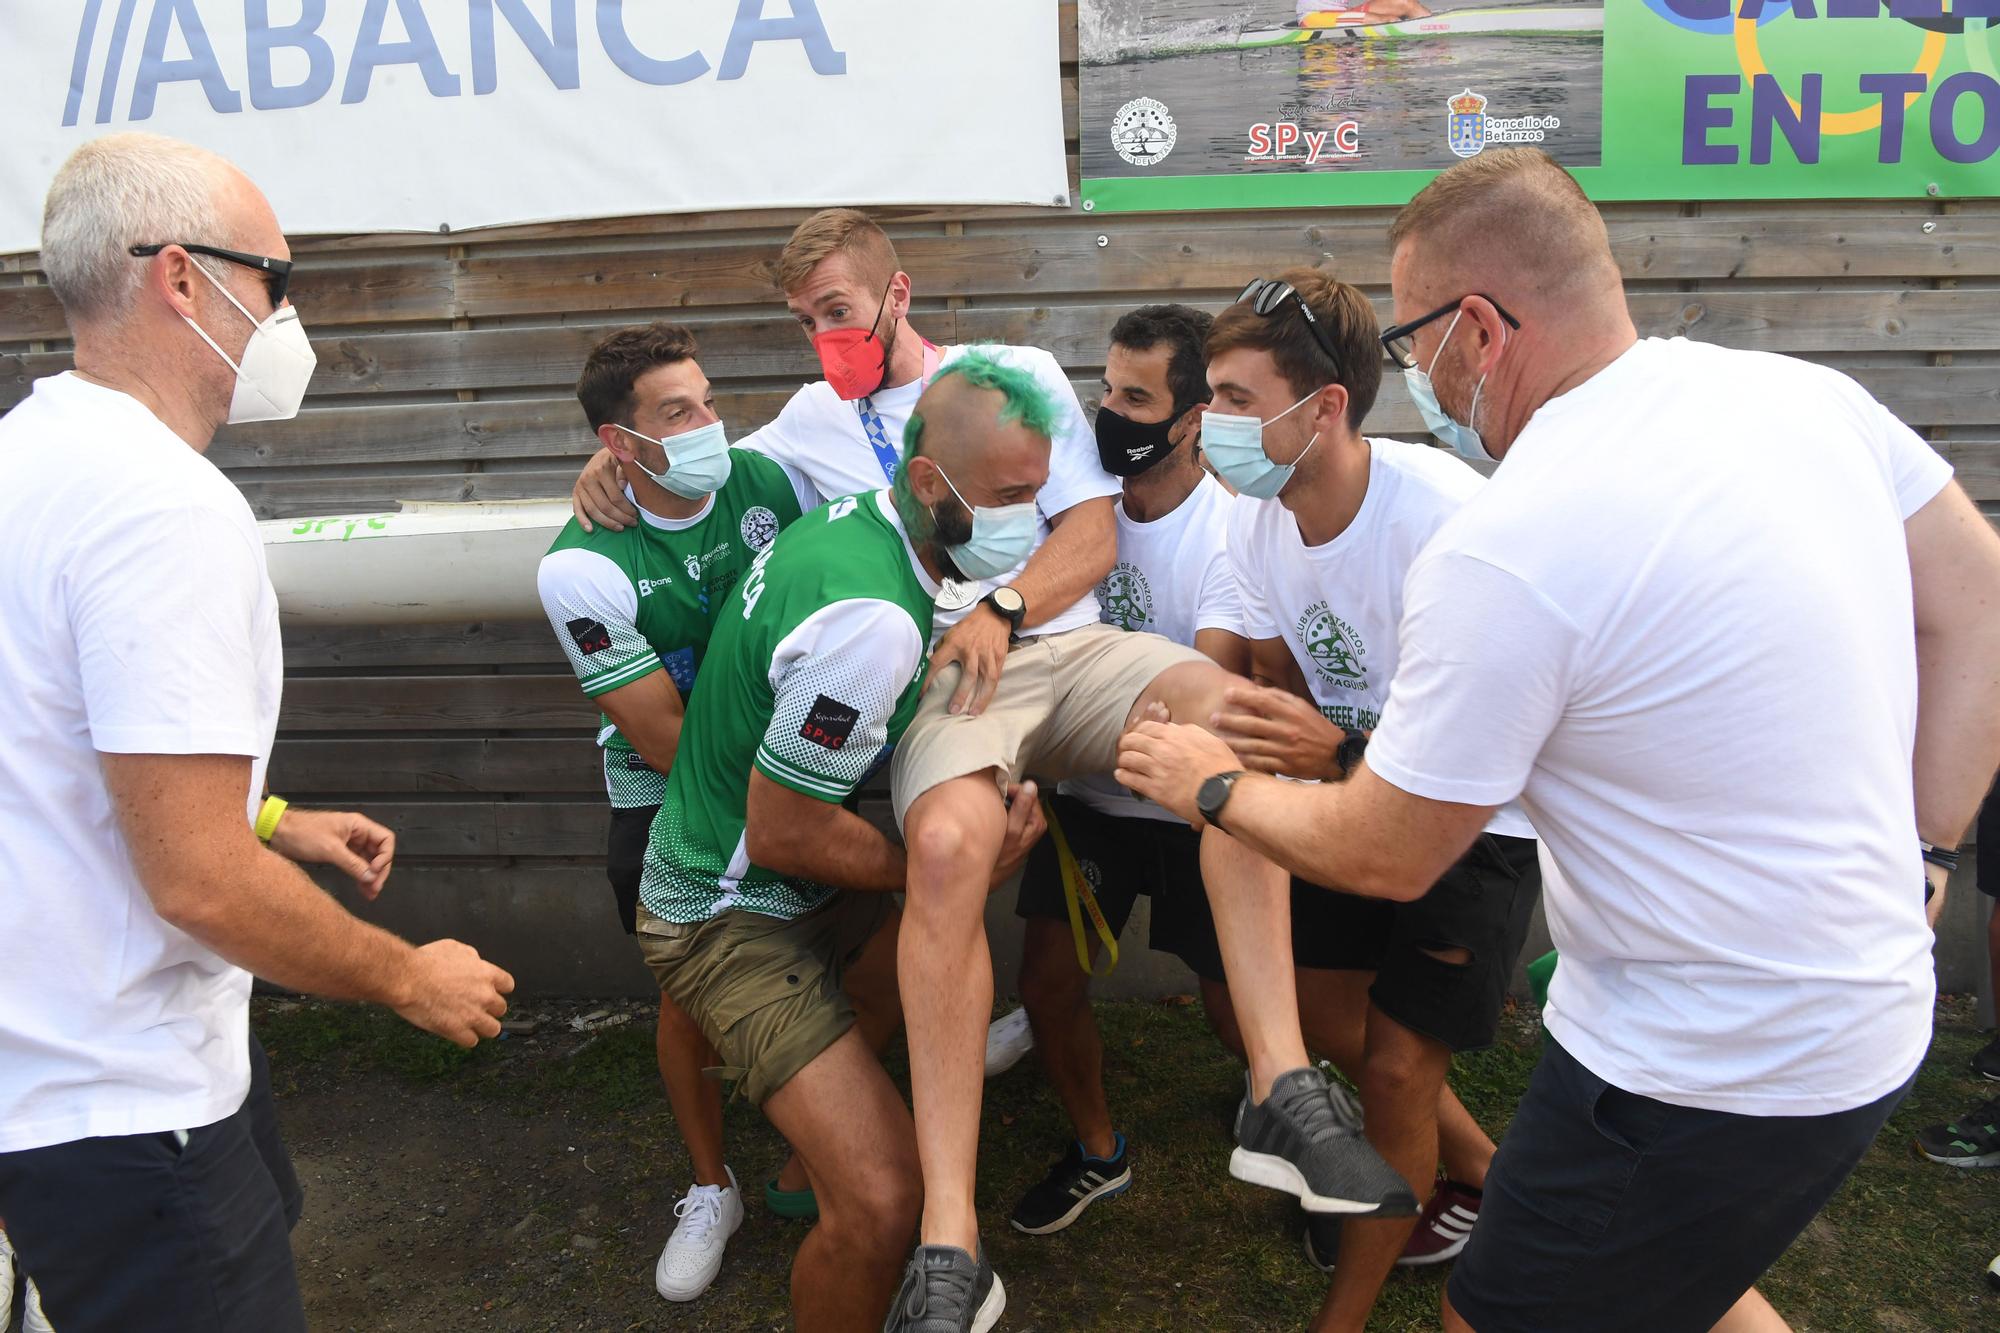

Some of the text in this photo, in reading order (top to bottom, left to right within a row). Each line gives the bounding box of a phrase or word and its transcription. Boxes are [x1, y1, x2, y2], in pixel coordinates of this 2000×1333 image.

[127, 0, 847, 121] ABANCA
[1485, 116, 1560, 129] Concello de
[1682, 71, 2000, 165] EN TO
[1485, 130, 1543, 141] Betanzos
[1126, 444, 1154, 455] Reebok
[1121, 562, 1153, 609] DE BETANZOS
[1305, 604, 1320, 618] RÍA
[1320, 600, 1329, 609] D
[1315, 668, 1369, 691] PIRAGÜISM
